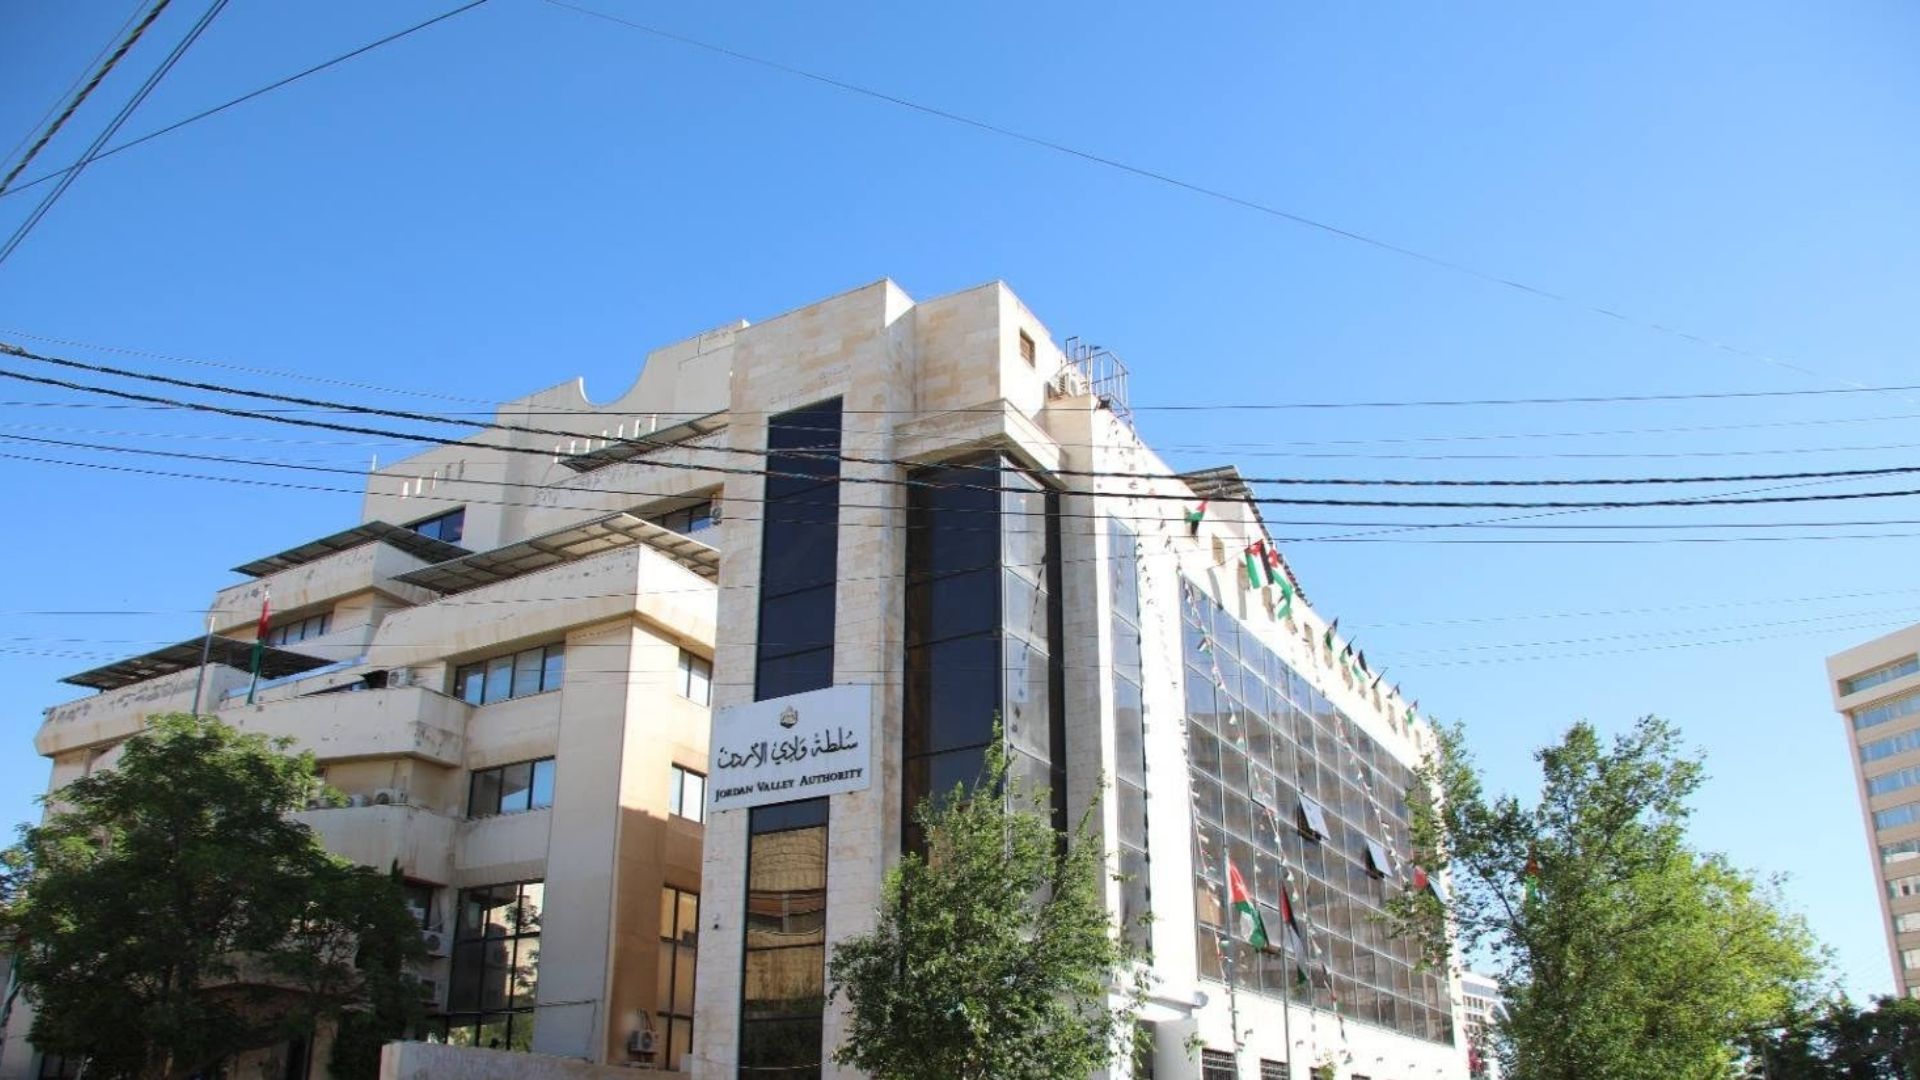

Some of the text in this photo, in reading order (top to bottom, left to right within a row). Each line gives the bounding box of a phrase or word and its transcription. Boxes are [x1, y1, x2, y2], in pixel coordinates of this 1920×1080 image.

[714, 768, 863, 802] JORDAN VALLEY AUTHORITY
